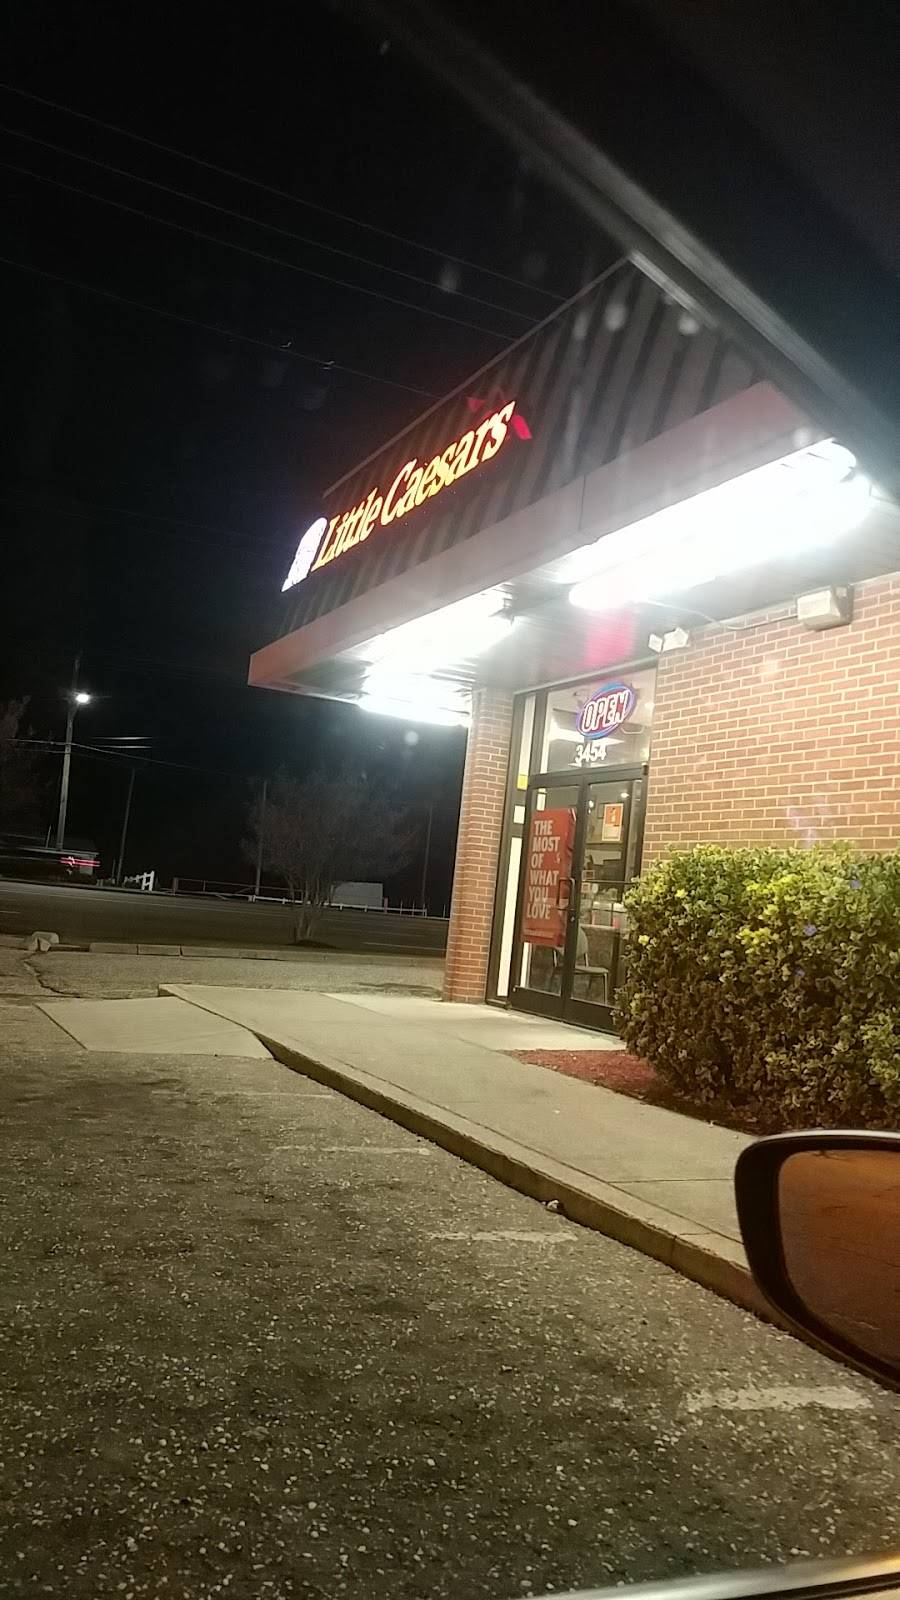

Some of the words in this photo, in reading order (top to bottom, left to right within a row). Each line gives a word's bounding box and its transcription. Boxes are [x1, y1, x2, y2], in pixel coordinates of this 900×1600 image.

[311, 487, 384, 572] Little
[380, 400, 516, 526] Caesars
[582, 689, 631, 732] OPEN
[575, 744, 607, 764] 3454
[534, 820, 554, 836] THE
[532, 836, 561, 852] MOST
[531, 853, 544, 868] OF
[529, 870, 560, 886] WHAT
[528, 886, 549, 903] YOU
[526, 904, 552, 920] LOVE
